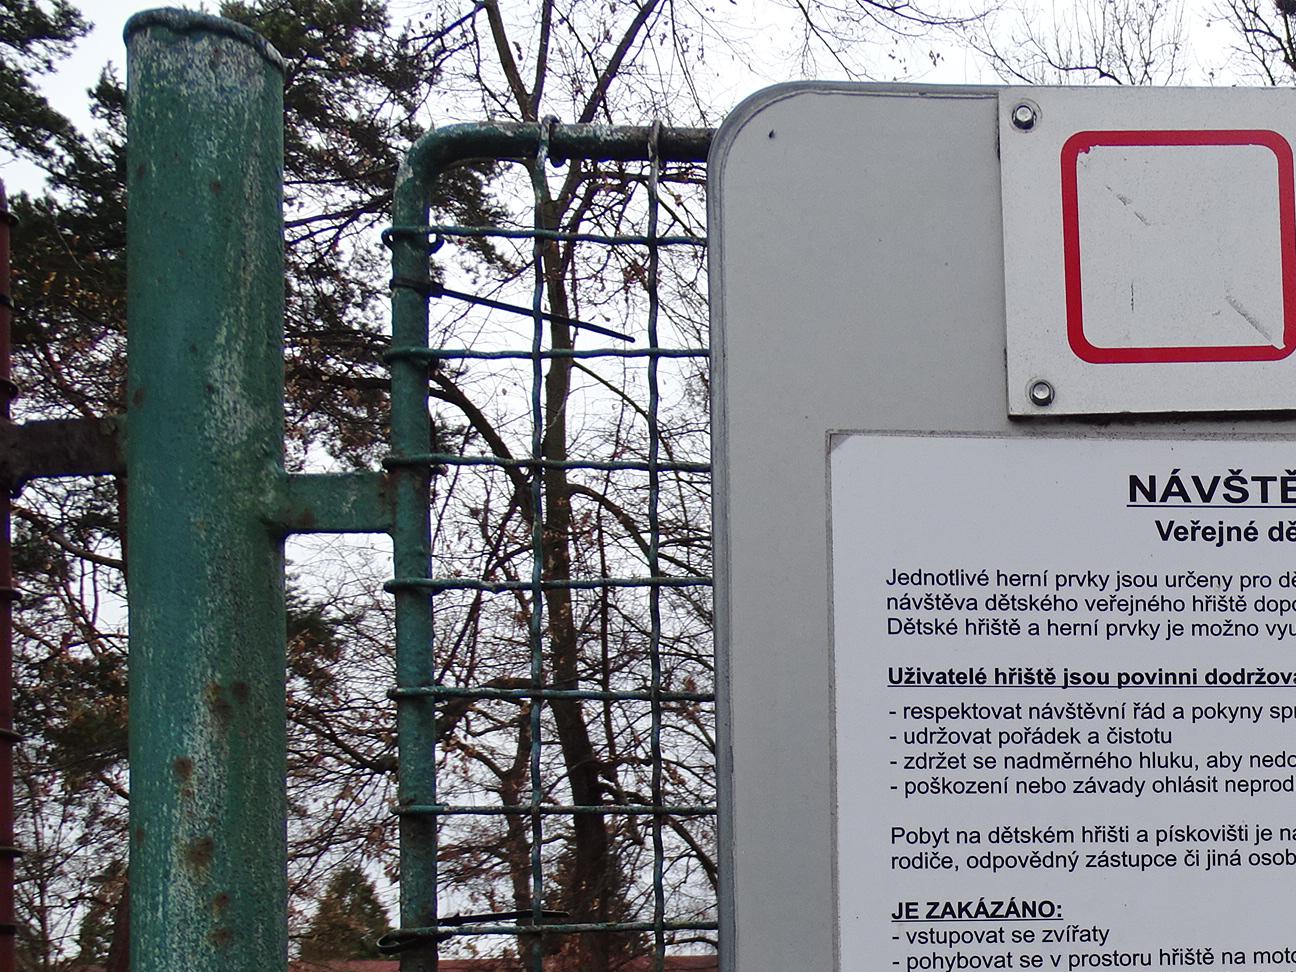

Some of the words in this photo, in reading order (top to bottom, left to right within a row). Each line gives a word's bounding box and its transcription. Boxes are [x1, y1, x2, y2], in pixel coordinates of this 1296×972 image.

[1154, 519, 1259, 548] Veřejné
[886, 592, 978, 611] návštěva
[984, 593, 1079, 612] dětského
[1084, 594, 1186, 617] veřejného
[1192, 594, 1248, 613] hřiště
[887, 617, 958, 636] Dětské
[965, 617, 1021, 636] hřiště
[1027, 622, 1040, 637] a
[1047, 618, 1099, 637] herní
[1106, 618, 1161, 641] prvky
[1165, 619, 1185, 641] je
[1191, 618, 1259, 637] možno
[888, 666, 987, 685] Uživatelé
[994, 667, 1057, 686] hřiště
[1062, 667, 1110, 690] jsou
[1117, 667, 1198, 690] povinni
[903, 701, 1023, 724] respektovat
[1028, 701, 1127, 720] návštěvní
[1132, 702, 1166, 720] řád
[1172, 706, 1185, 720] a
[1191, 701, 1264, 724] pokyny
[903, 726, 992, 745] udržovat
[998, 726, 1082, 749] pořádek
[1087, 730, 1100, 745] a
[1106, 726, 1172, 745] čistotu
[904, 776, 1009, 799] poškození
[1016, 776, 1067, 795] nebo
[1072, 775, 1146, 798] závady
[1152, 775, 1219, 794] ohlásit
[891, 851, 959, 872] rodiče,
[966, 850, 1080, 873] odpovědný
[1085, 849, 1178, 872] zástupce
[1184, 849, 1200, 867] či
[1205, 848, 1242, 871] jiná
[891, 901, 920, 920] JE
[925, 896, 1062, 920] ZAKÁZÁNO:
[905, 926, 1006, 949] vstupovat
[1011, 929, 1036, 944] se
[1041, 924, 1110, 947] zvířaty
